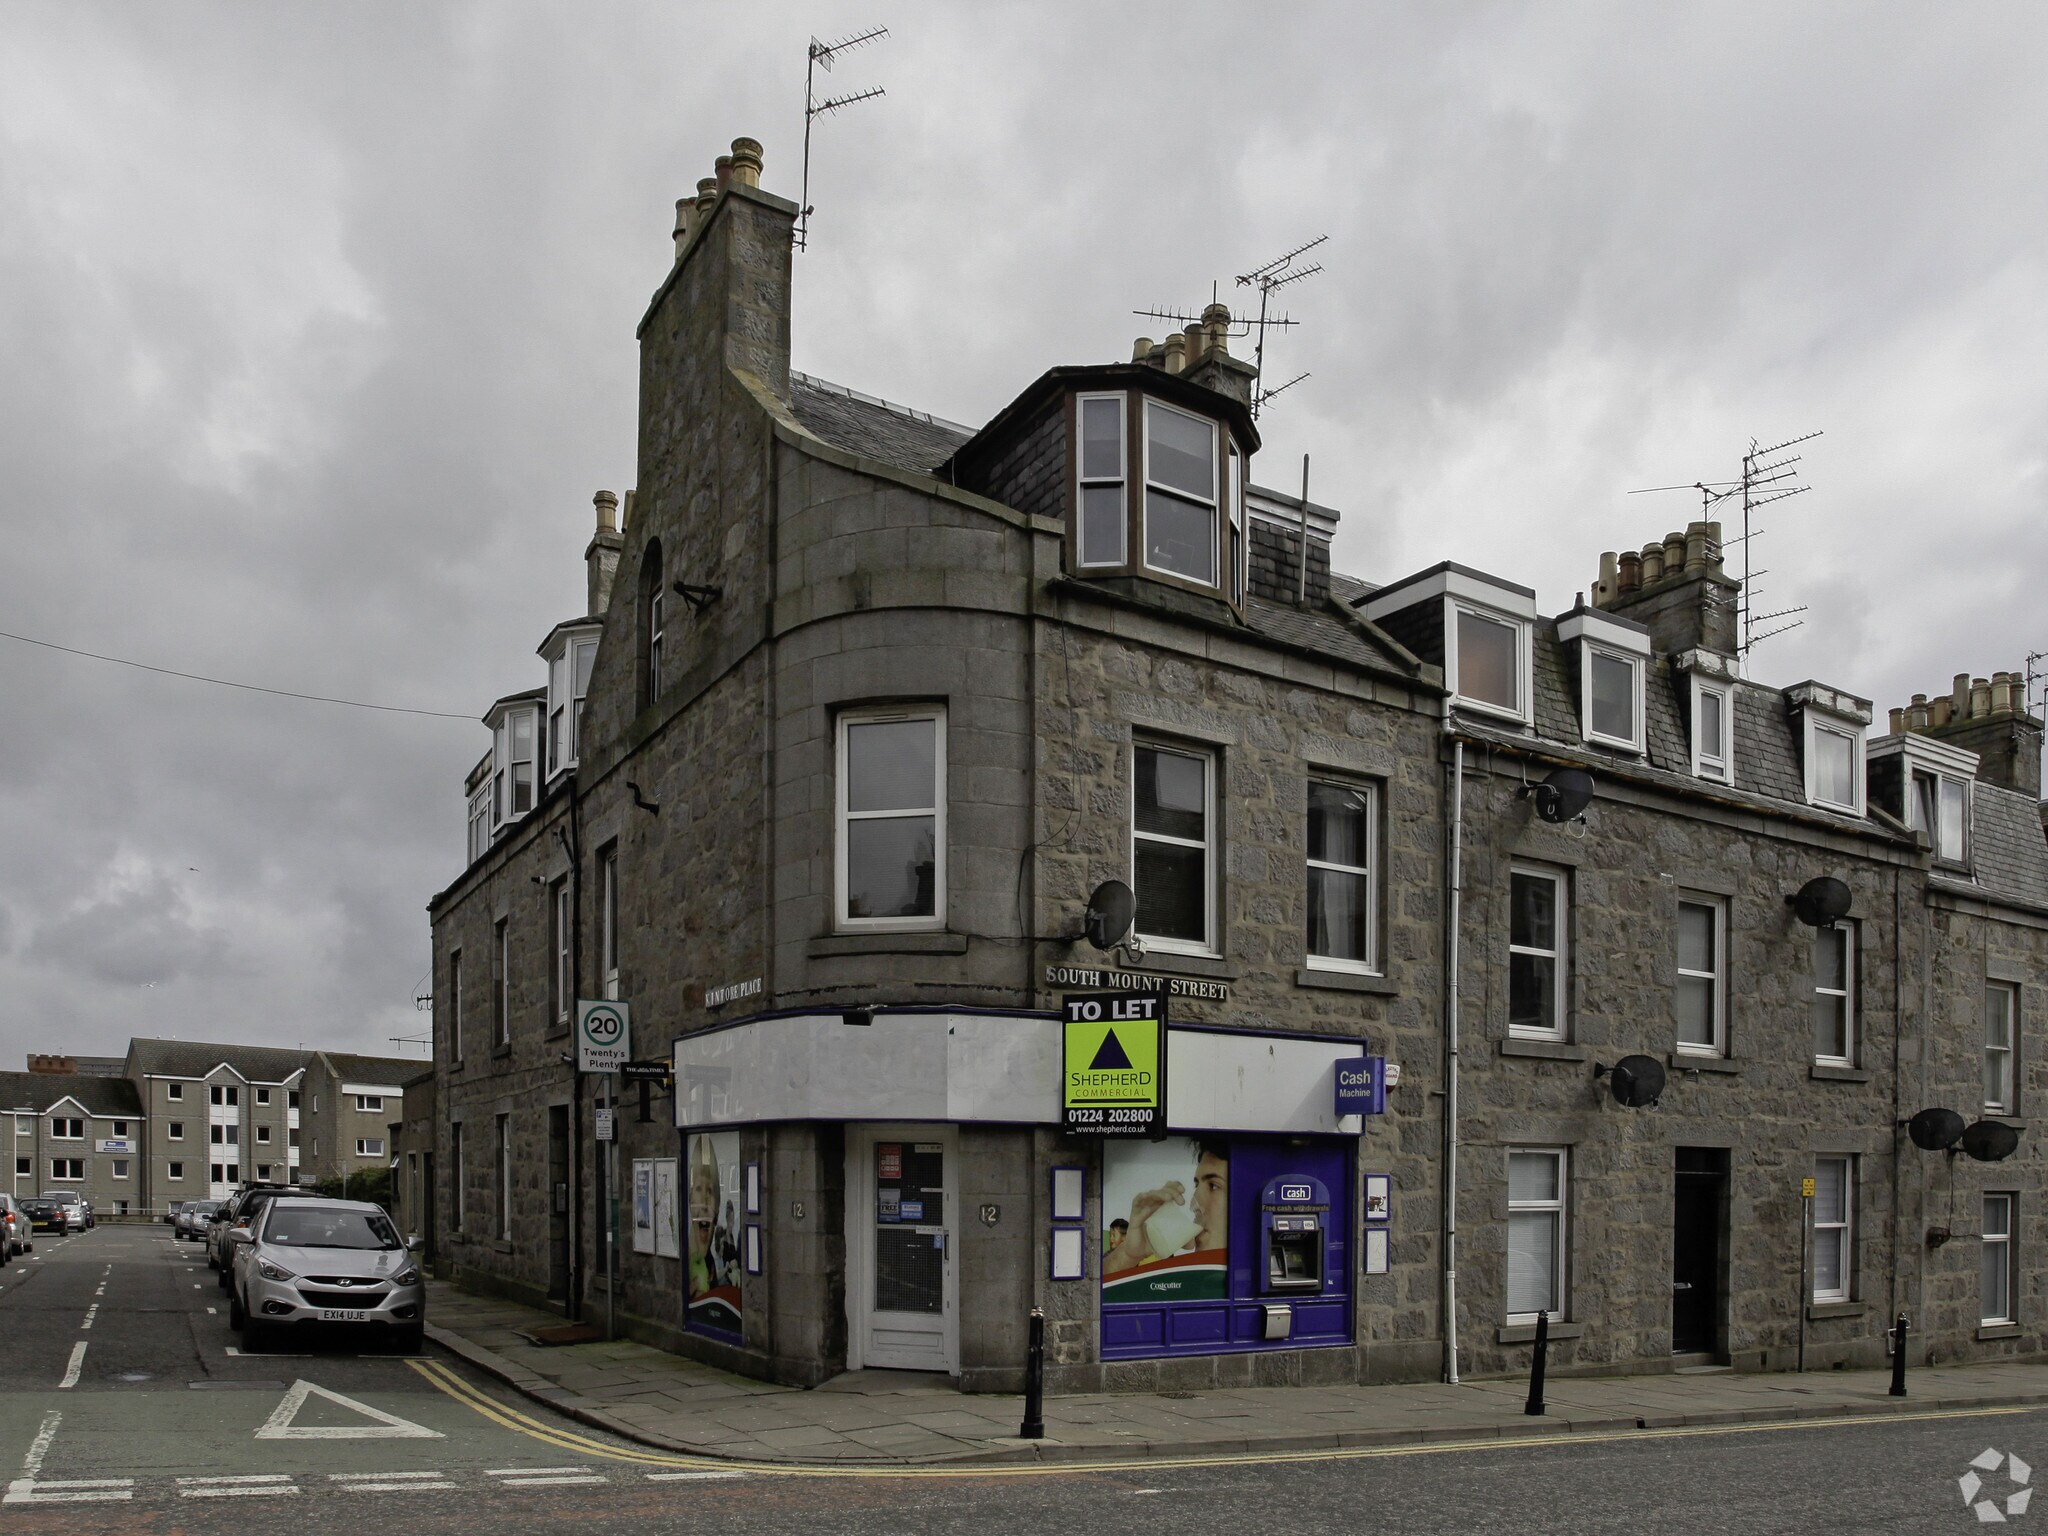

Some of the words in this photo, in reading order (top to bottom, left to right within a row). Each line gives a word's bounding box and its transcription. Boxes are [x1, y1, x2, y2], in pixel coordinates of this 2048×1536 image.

[1046, 965, 1100, 987] SOUTH
[1108, 972, 1163, 991] MOUNT
[1170, 979, 1228, 1000] STREET
[705, 985, 738, 1007] KINTORE
[740, 977, 761, 997] PLACE
[1068, 1000, 1101, 1021] TO
[1112, 999, 1157, 1020] LET
[590, 1017, 618, 1035] 20
[583, 1048, 625, 1058] Twenty's
[589, 1060, 620, 1070] Plenty
[1071, 1071, 1151, 1087] SHEPHERD
[1340, 1070, 1371, 1085] Cash
[1075, 1088, 1146, 1098] COMMERCIAL
[1339, 1088, 1371, 1098] Machine
[1068, 1109, 1104, 1123] 01224
[1108, 1109, 1154, 1123] 202800
[1075, 1124, 1147, 1135] www.shepherd.co.uk
[1286, 1187, 1306, 1198] cash
[793, 1203, 804, 1217] 12
[981, 1206, 997, 1222] 12
[1263, 1204, 1276, 1212] Free
[1276, 1204, 1293, 1212] cash
[324, 1310, 345, 1320] EX14
[347, 1311, 366, 1320] UJE
